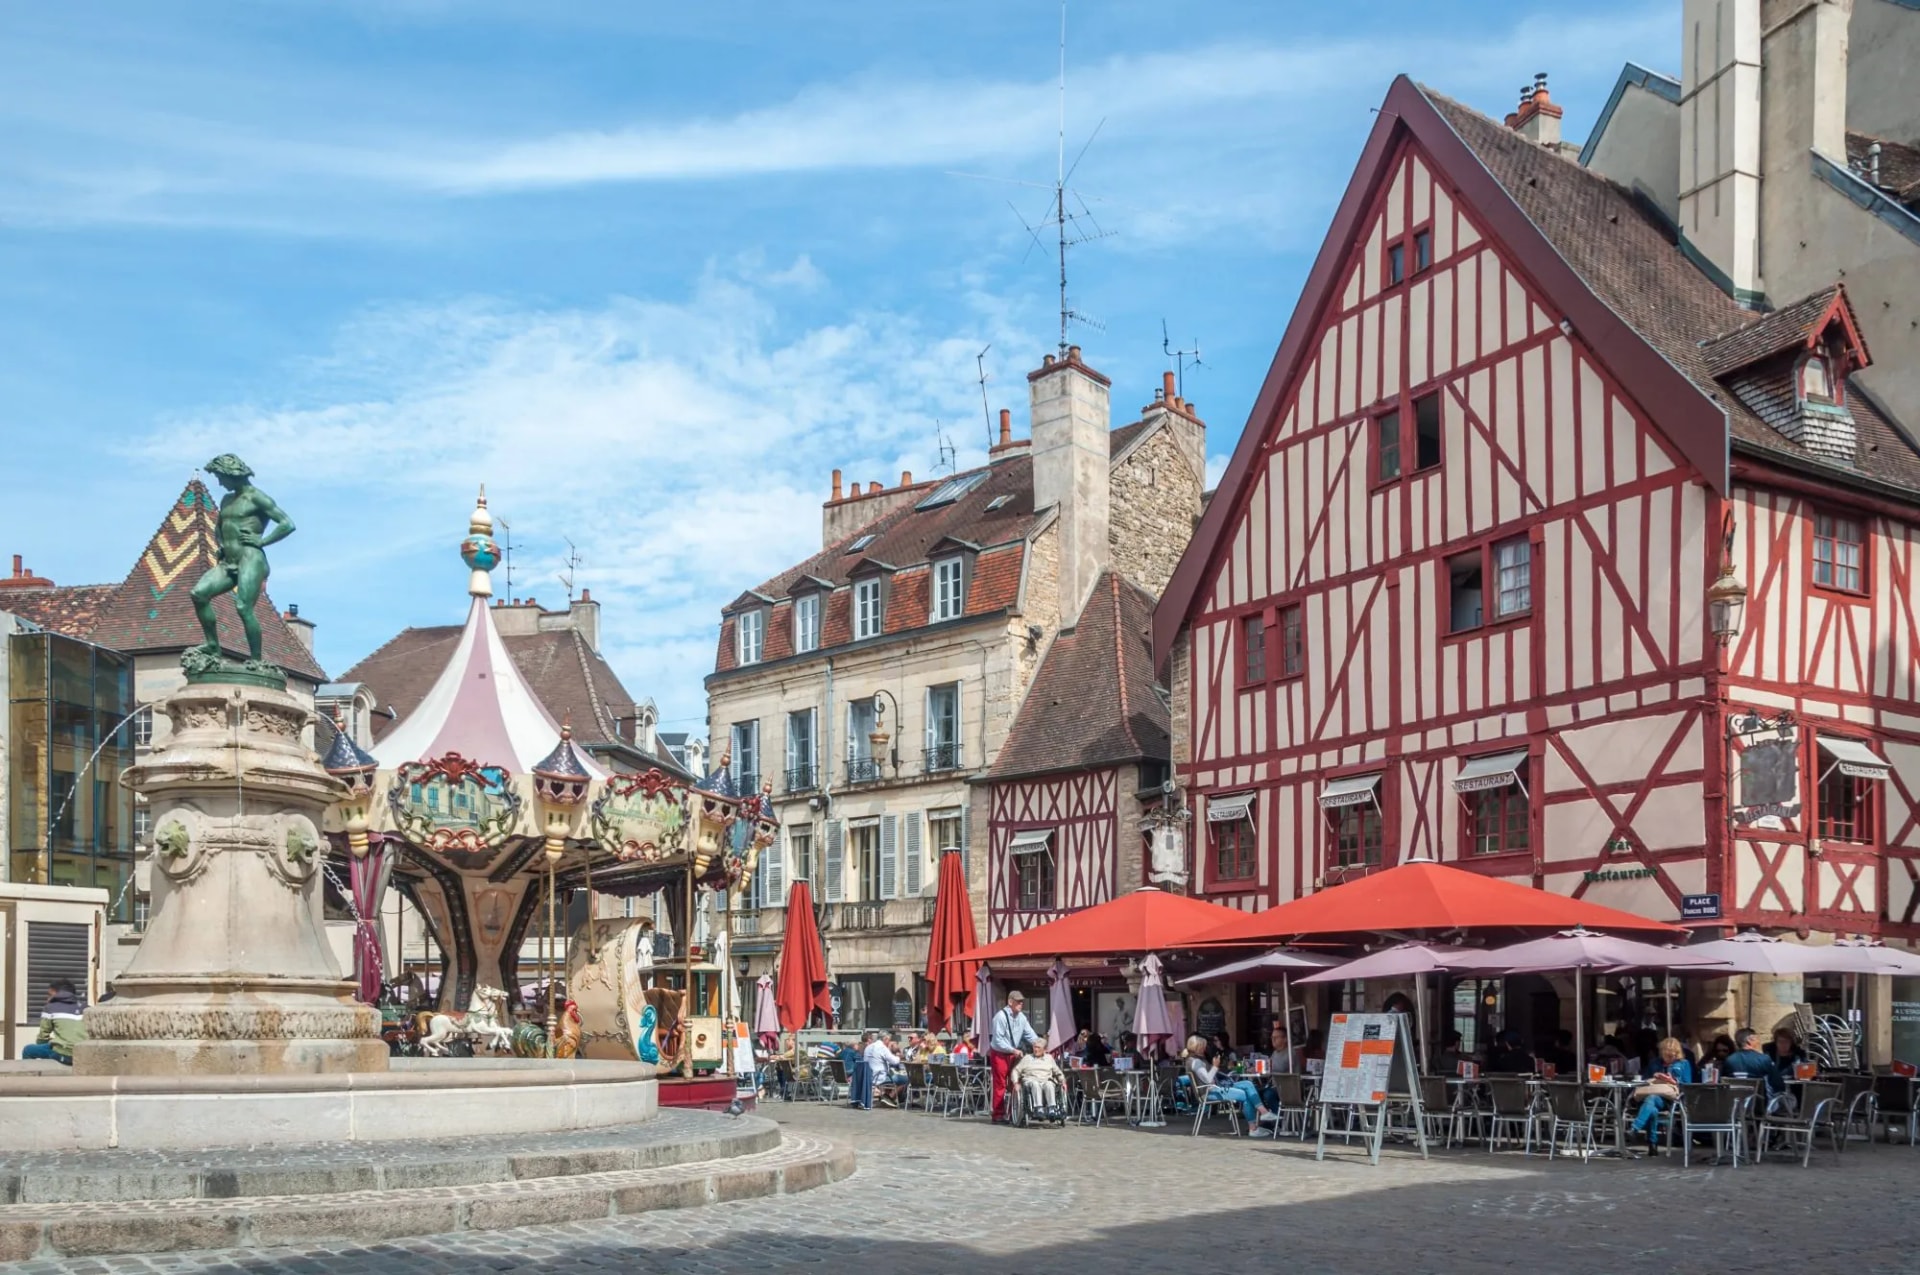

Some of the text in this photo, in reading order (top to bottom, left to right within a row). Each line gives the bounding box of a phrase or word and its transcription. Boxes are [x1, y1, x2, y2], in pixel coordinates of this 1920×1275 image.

[1458, 774, 1511, 791] RESTAURANT
[1608, 839, 1632, 851] Bar
[1584, 867, 1657, 882] Restaurant
[1689, 897, 1711, 905] PLACE
[1702, 906, 1717, 914] RUDE
